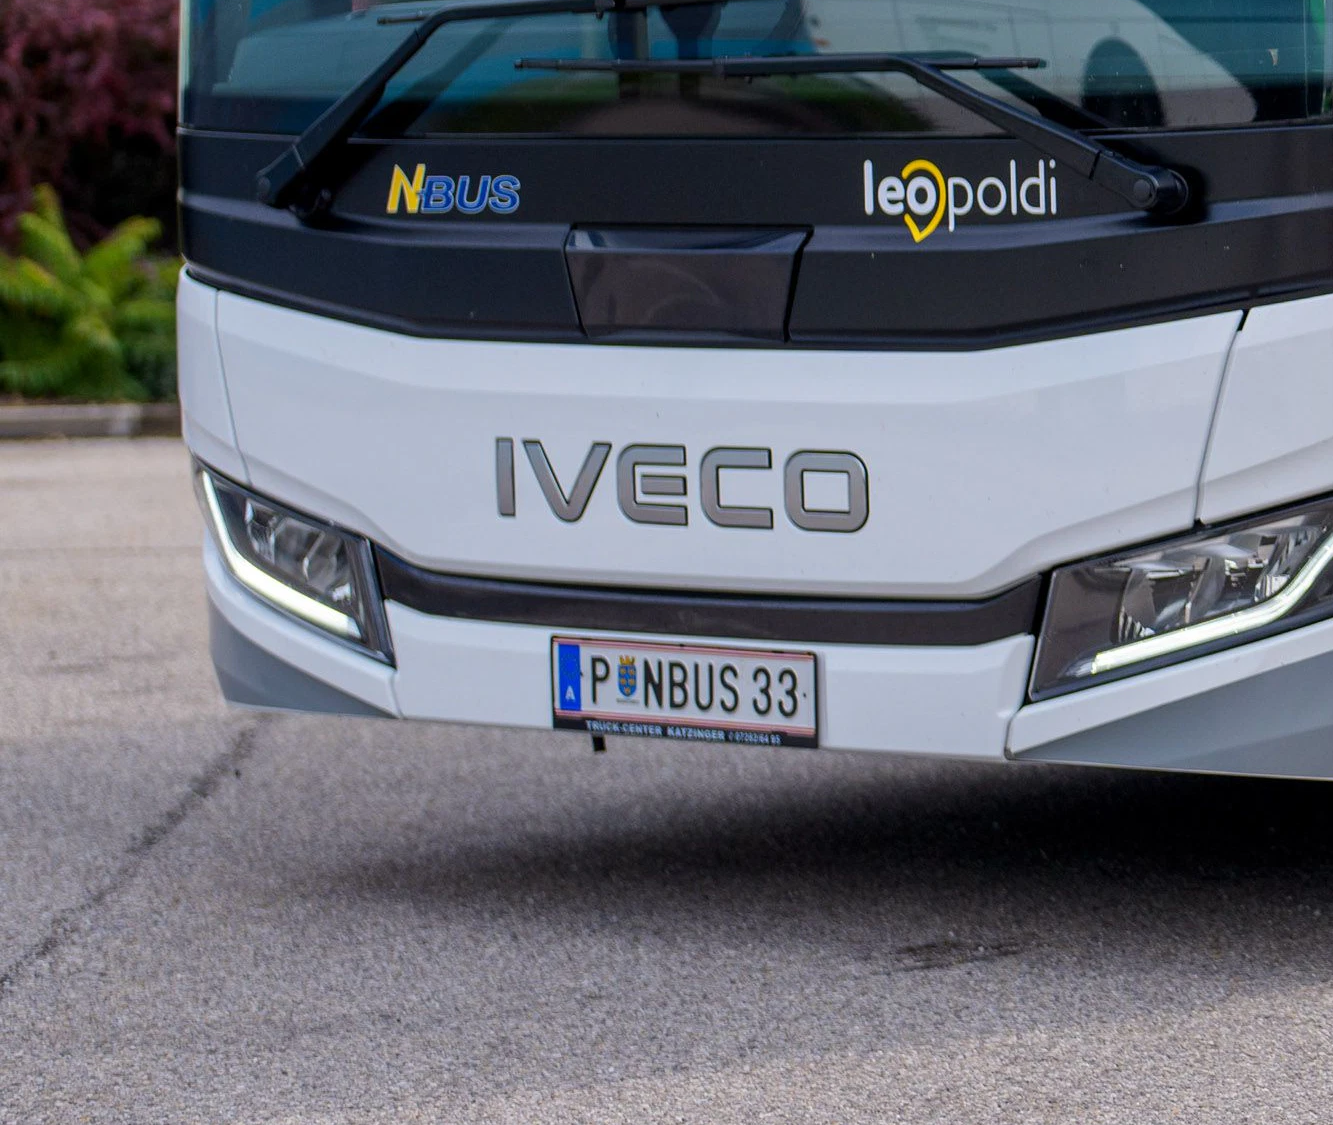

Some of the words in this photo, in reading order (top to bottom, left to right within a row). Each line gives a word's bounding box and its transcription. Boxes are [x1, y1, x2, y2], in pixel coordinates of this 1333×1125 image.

[386, 163, 521, 215] NBUS
[864, 157, 1058, 233] leopoldi
[495, 436, 869, 533] IVECO
[590, 656, 611, 705] P
[643, 658, 740, 713] NBUS
[751, 665, 798, 718] 33
